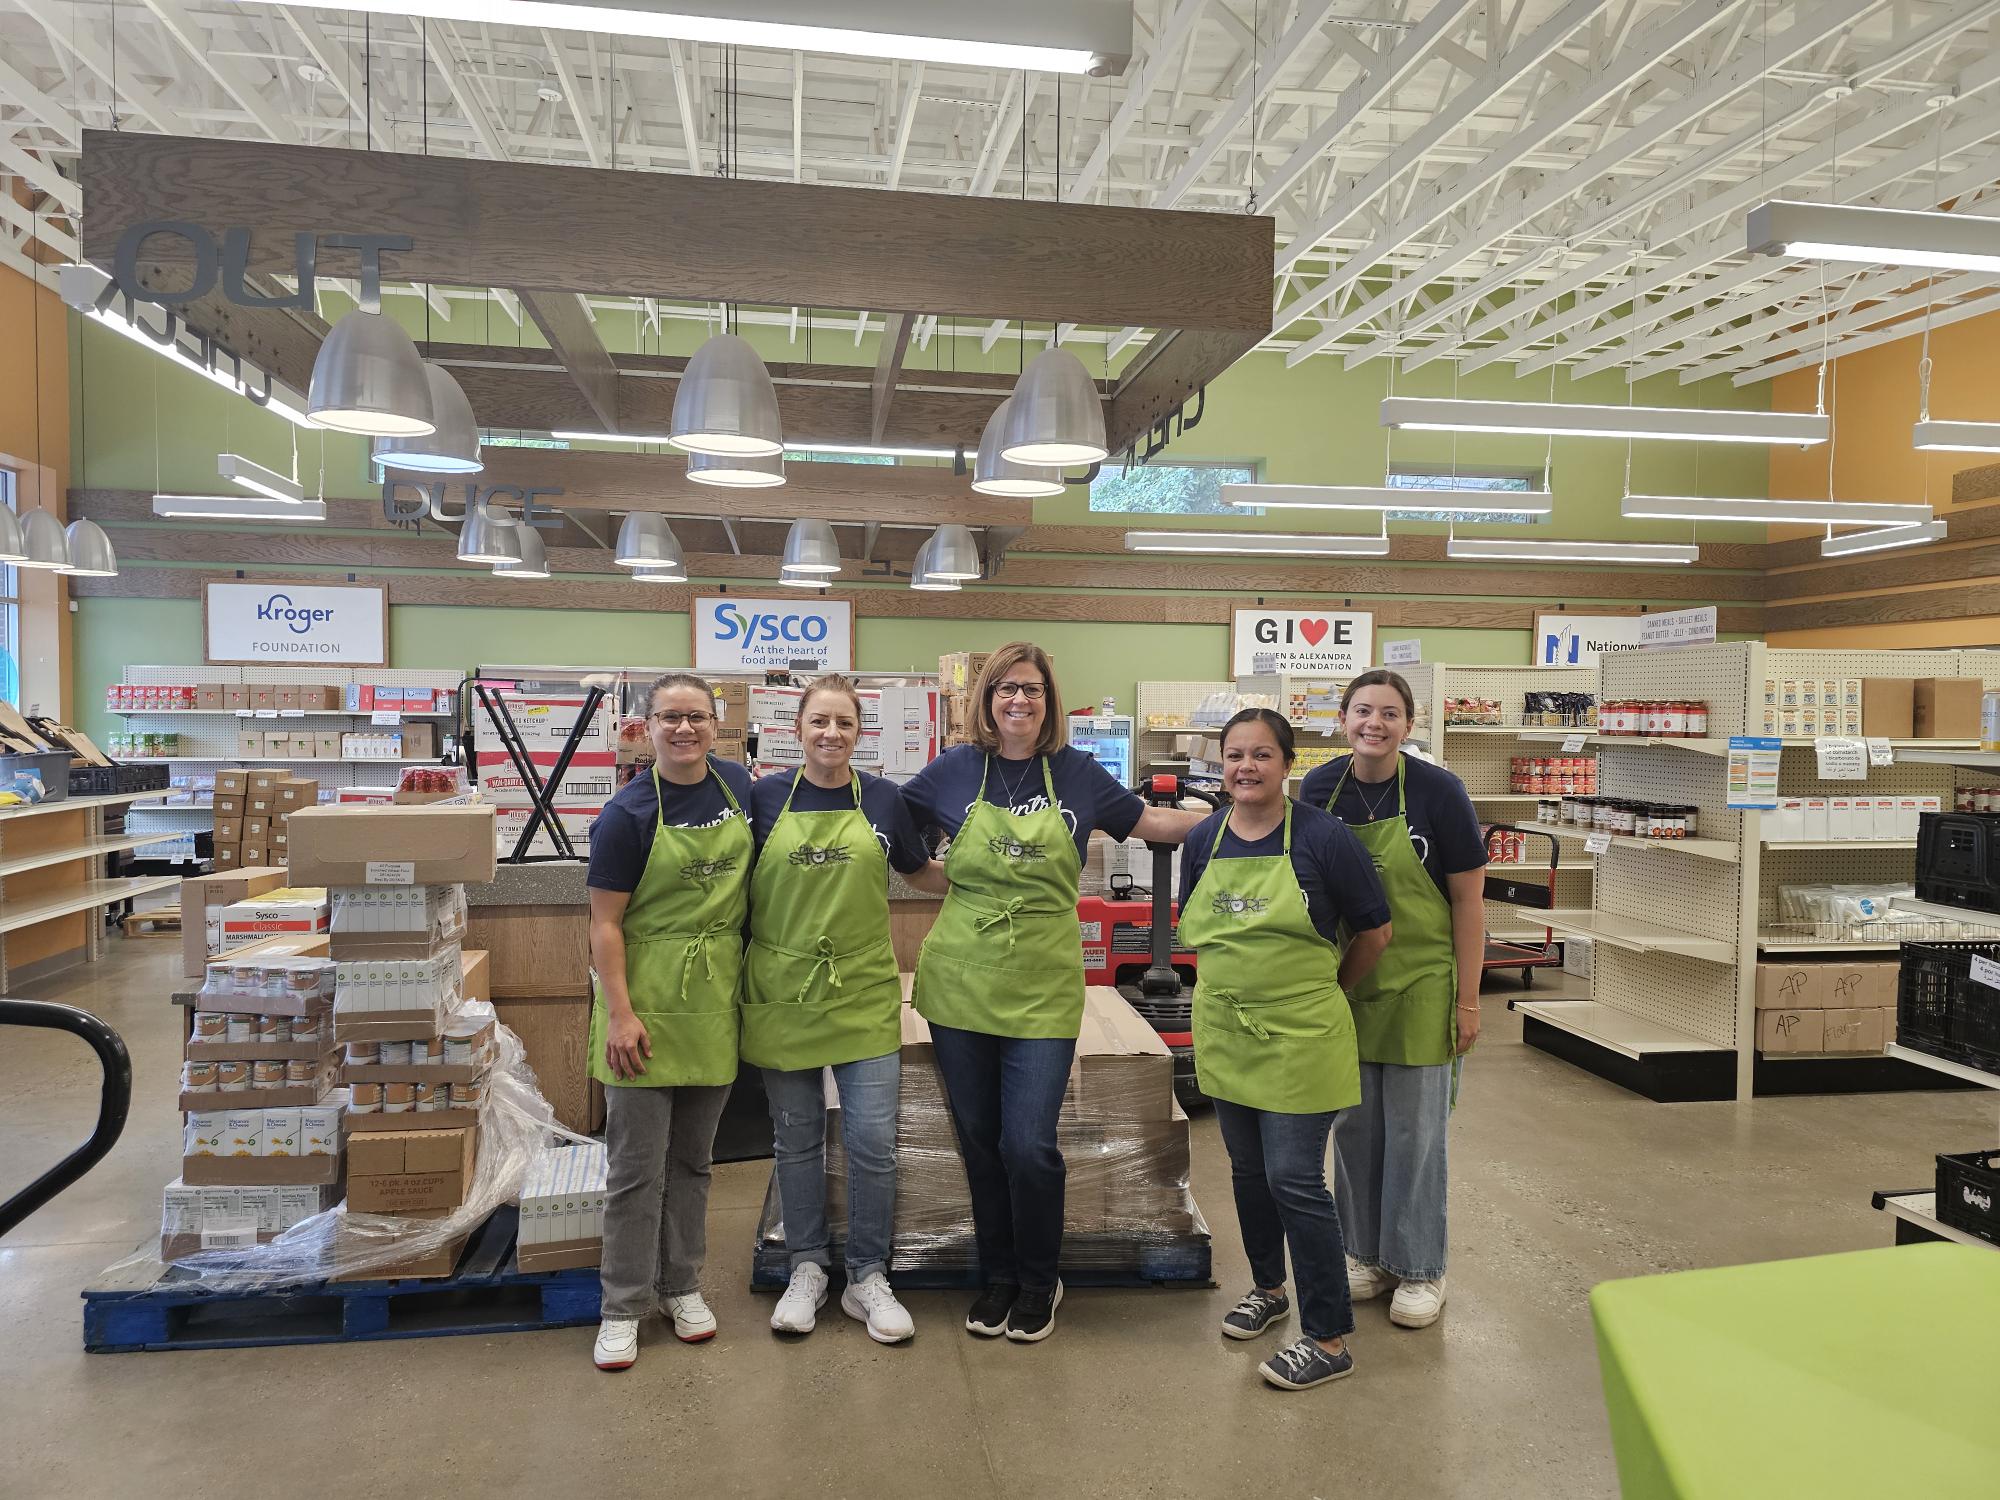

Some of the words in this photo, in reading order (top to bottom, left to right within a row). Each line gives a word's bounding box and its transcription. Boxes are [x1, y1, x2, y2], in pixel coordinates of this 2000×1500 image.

[113, 221, 412, 315] OUT
[257, 593, 334, 634] Kroger
[252, 641, 341, 653] FOUNDATION
[753, 645, 765, 654] At
[767, 645, 785, 654] the
[787, 645, 815, 655] heart
[817, 646, 828, 655] of
[1587, 640, 1642, 652] Nationwi
[741, 655, 766, 665] food
[769, 656, 789, 665] and
[1299, 652, 1352, 661] ALEXANDRA
[1290, 662, 1352, 671] FOUNDATION
[989, 839, 1046, 857] STORE
[255, 911, 279, 920] Sysco
[253, 921, 283, 931] Classic
[1779, 971, 1808, 999] AP
[1834, 973, 1863, 998] AP
[1775, 1014, 1800, 1037] AP
